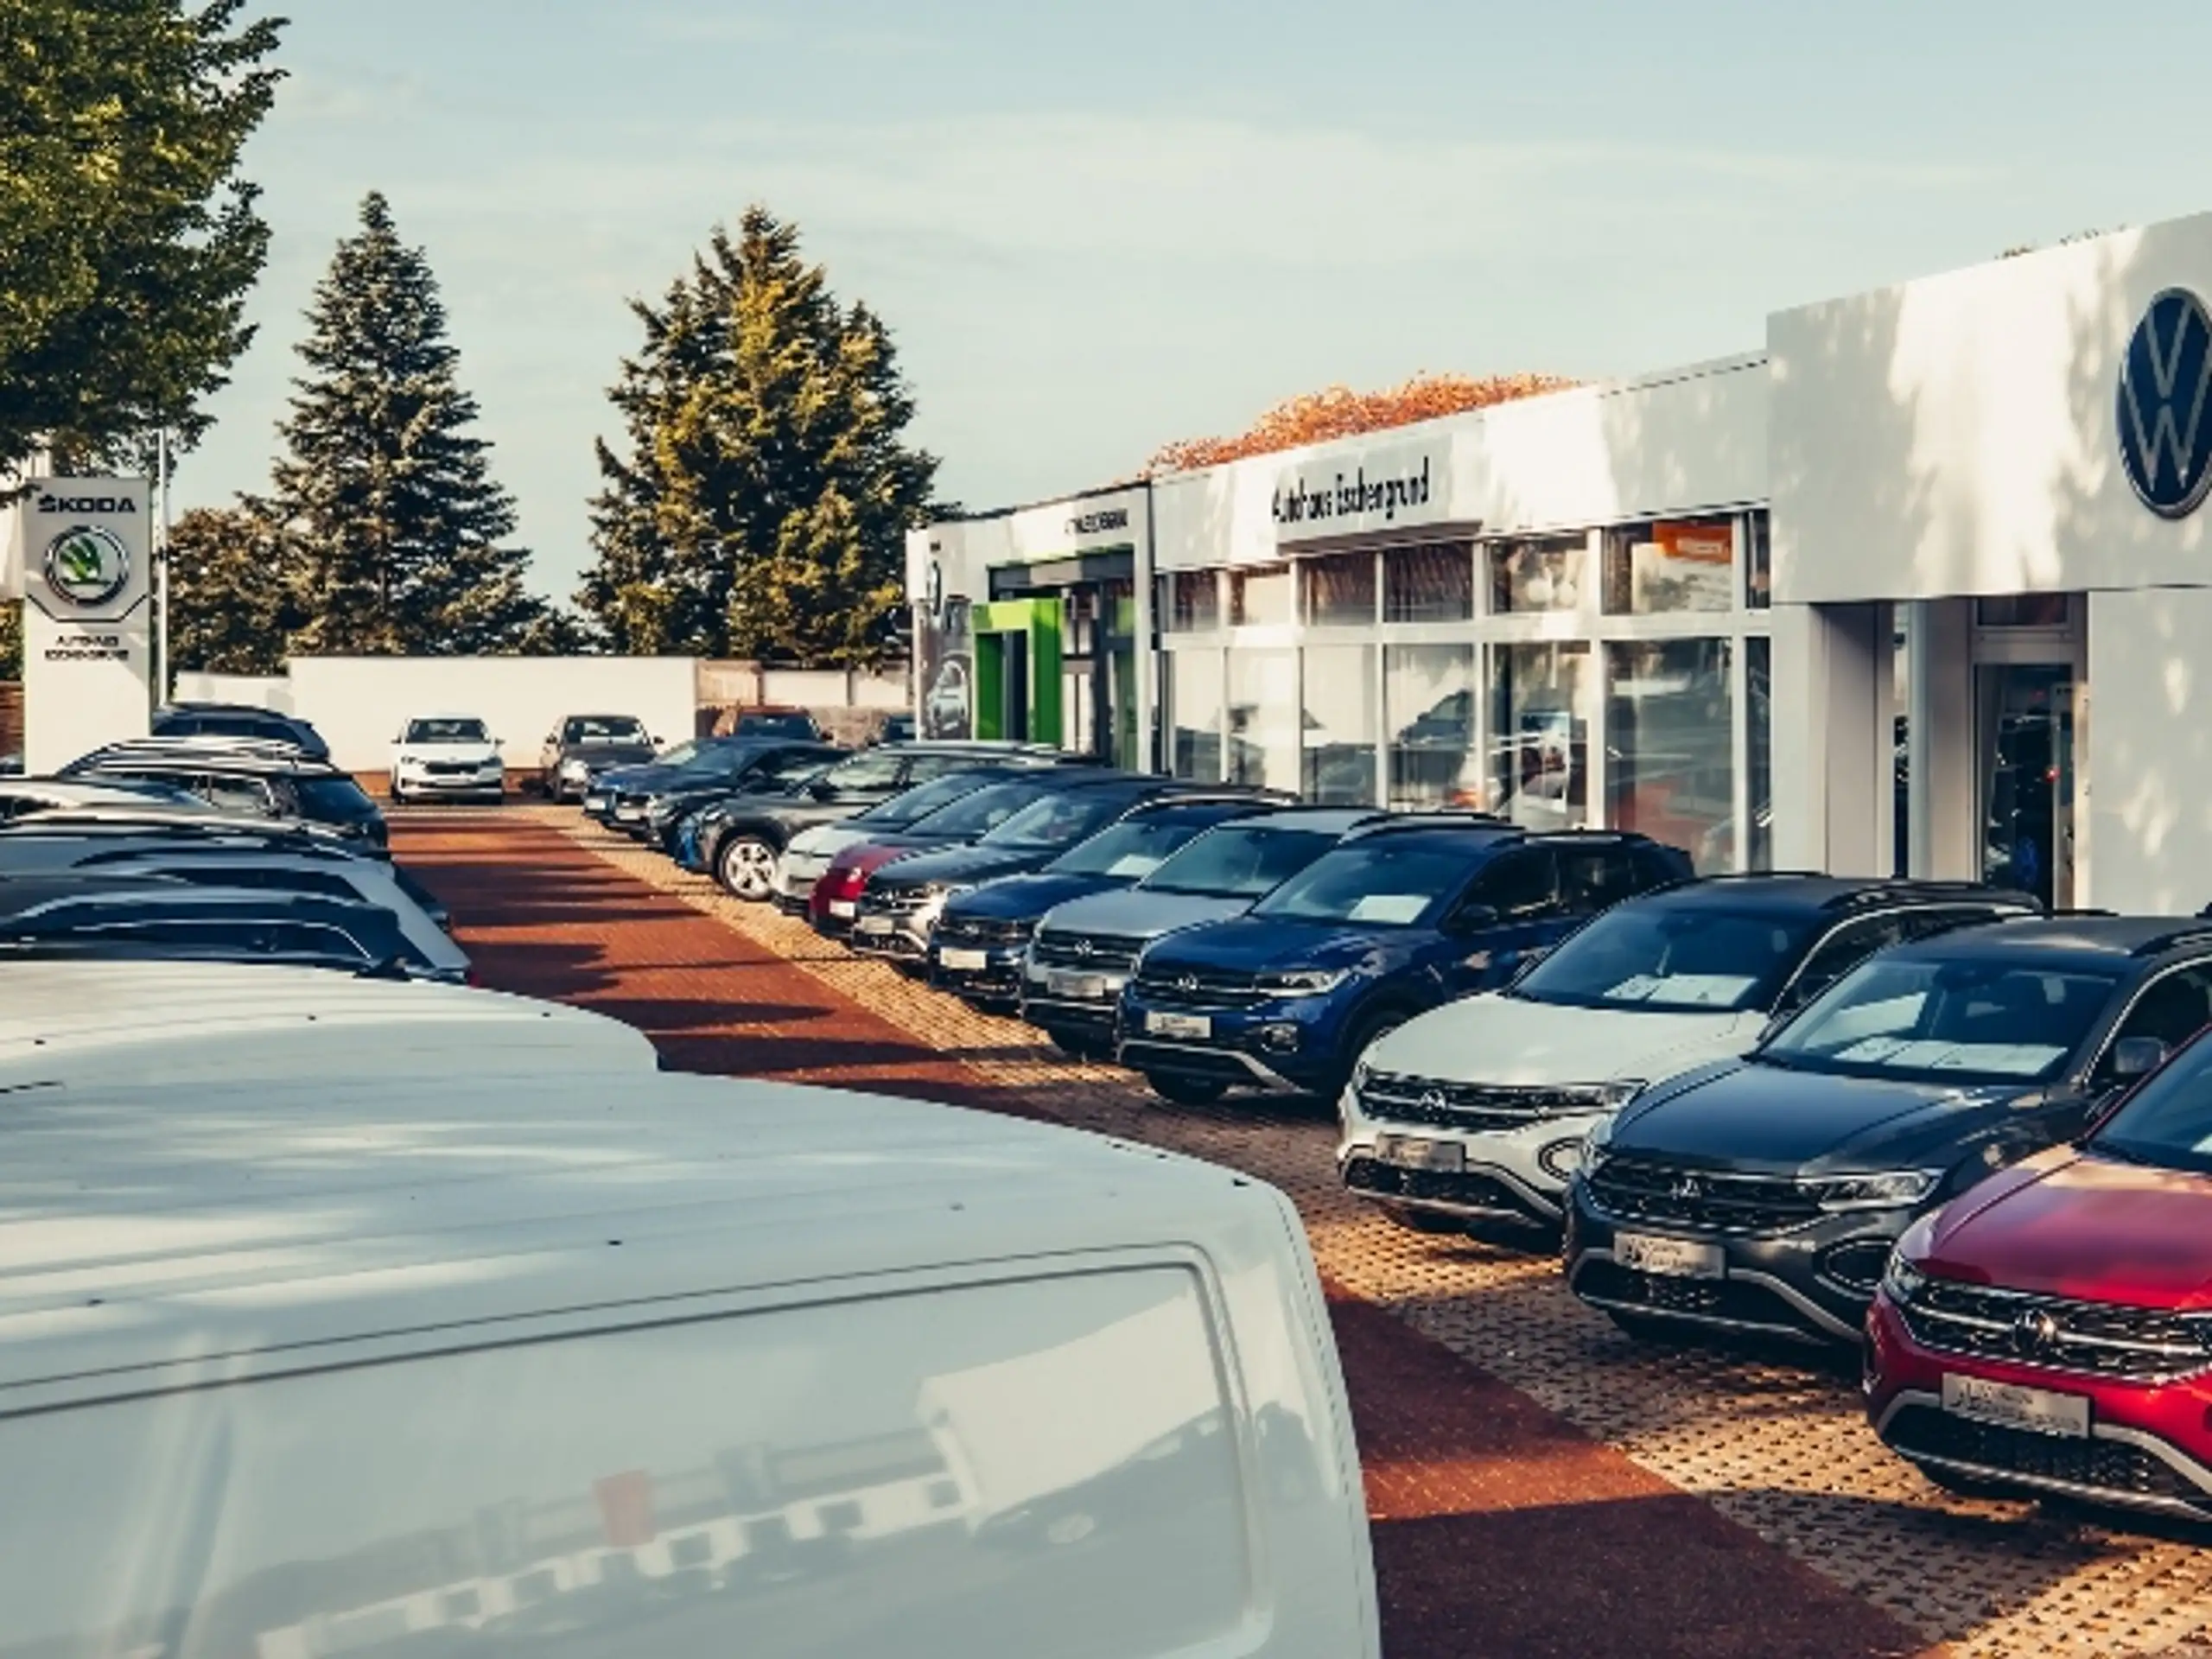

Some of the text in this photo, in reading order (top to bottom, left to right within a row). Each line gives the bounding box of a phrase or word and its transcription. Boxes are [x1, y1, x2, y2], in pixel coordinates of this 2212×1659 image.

[38, 493, 137, 513] ŠKODA
[1273, 455, 1429, 523] Autohaus Eschengrund
